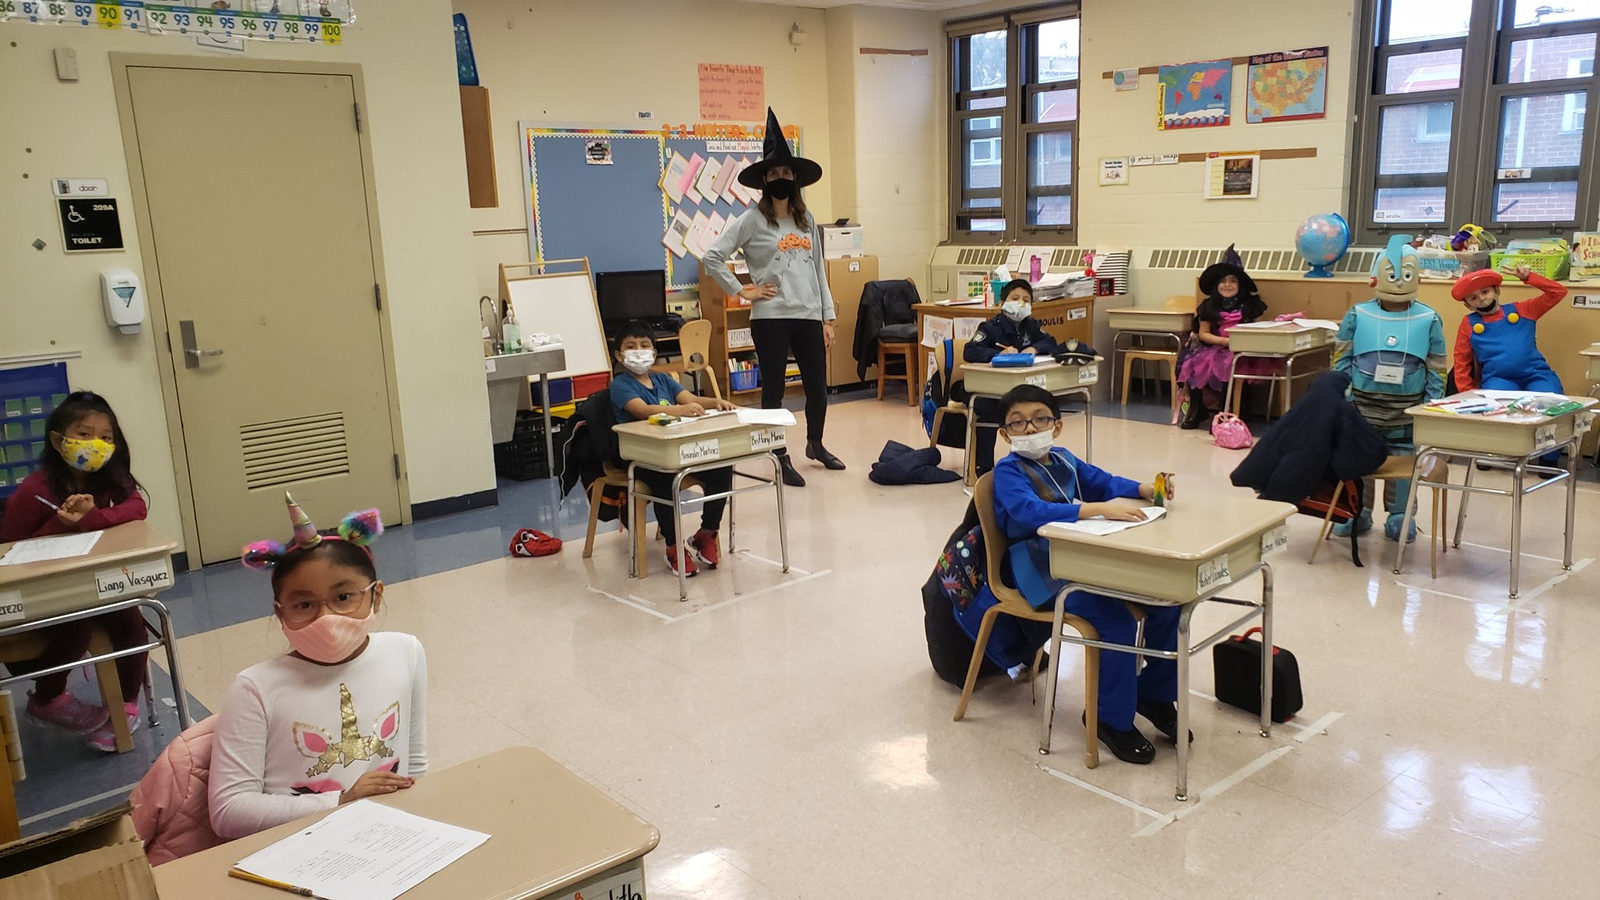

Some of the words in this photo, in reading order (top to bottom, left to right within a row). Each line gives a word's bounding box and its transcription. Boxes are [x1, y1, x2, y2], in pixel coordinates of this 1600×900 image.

[75, 5, 92, 17] 89
[100, 7, 117, 20] 90
[124, 9, 140, 21] 91
[150, 12, 167, 25] 92
[174, 14, 190, 26] 93
[197, 15, 213, 28] 94
[220, 17, 235, 29] 95
[242, 19, 257, 31] 96
[263, 20, 278, 32] 97
[284, 22, 299, 34] 98
[304, 23, 319, 35] 99
[322, 24, 341, 36] 100
[79, 184, 97, 192] door
[71, 237, 102, 245] TOILET
[97, 578, 125, 594] Liang
[126, 571, 168, 587] Vasquez
